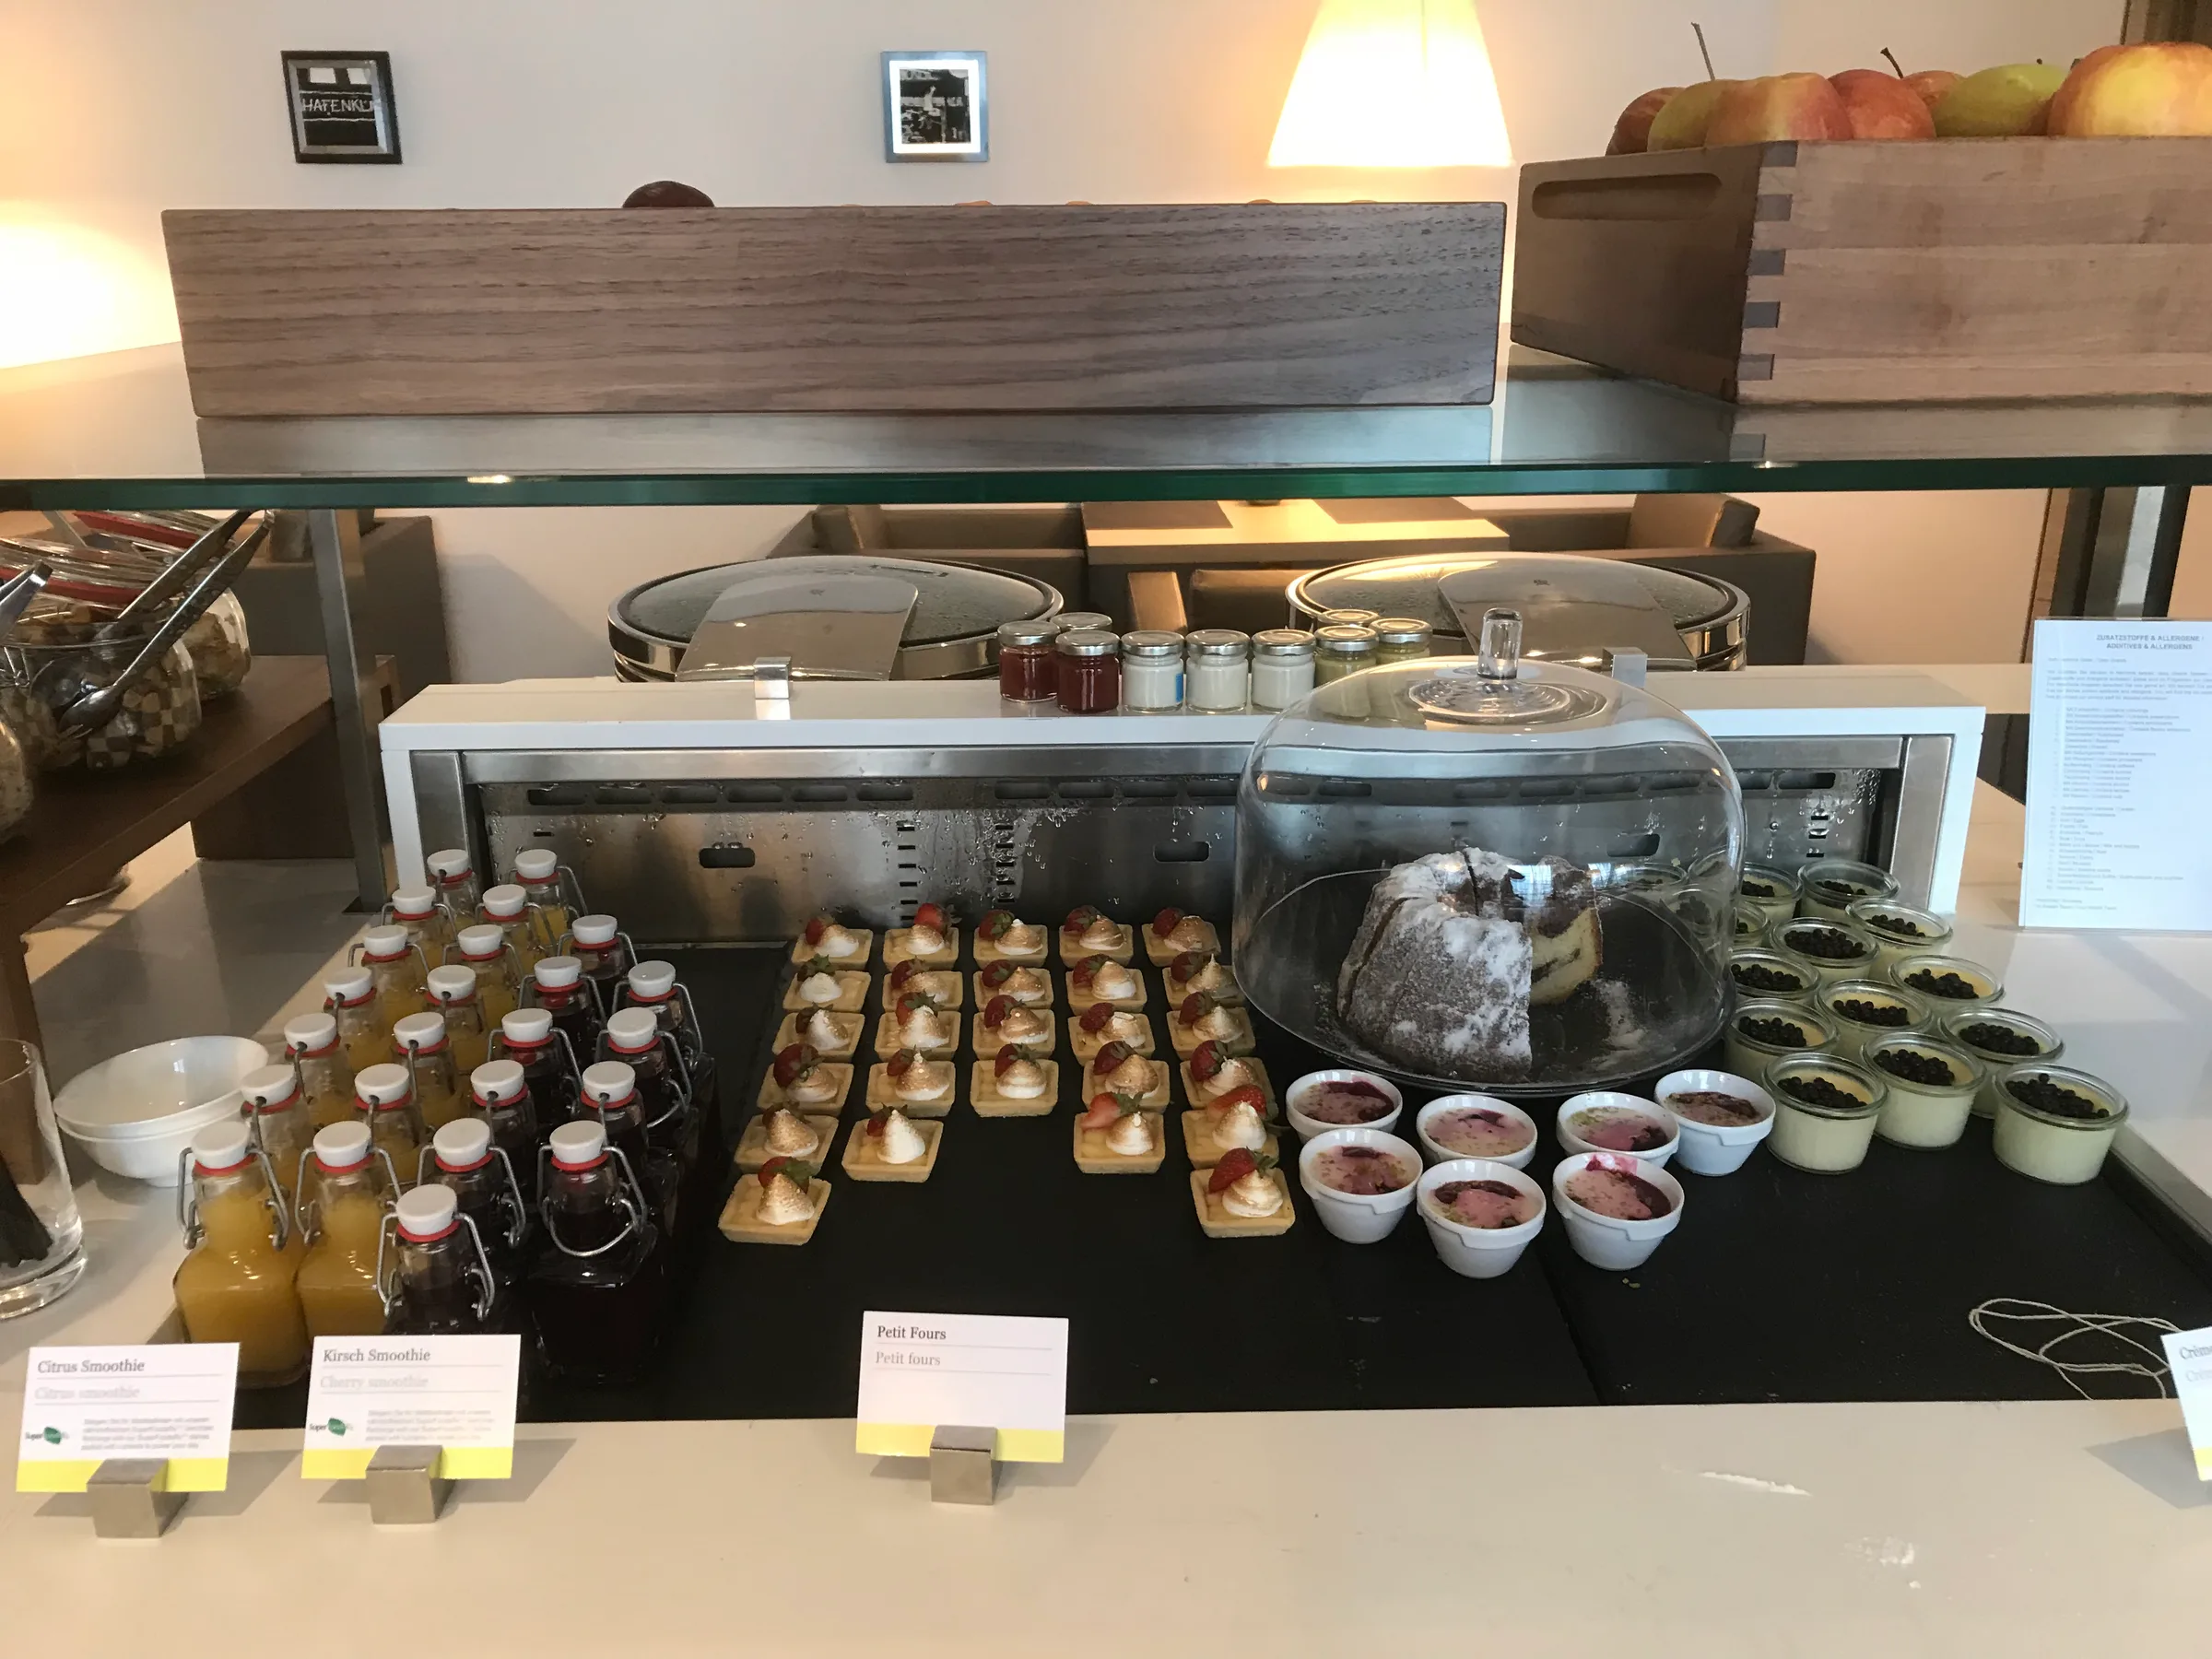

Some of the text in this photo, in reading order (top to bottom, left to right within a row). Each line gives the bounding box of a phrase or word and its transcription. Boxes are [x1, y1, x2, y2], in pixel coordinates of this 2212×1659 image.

[877, 1325, 947, 1340] Petit Fours
[324, 1347, 431, 1362] Kirsch Smoothie
[876, 1351, 941, 1366] Petit fours
[38, 1359, 145, 1373] Citrus Smoothie
